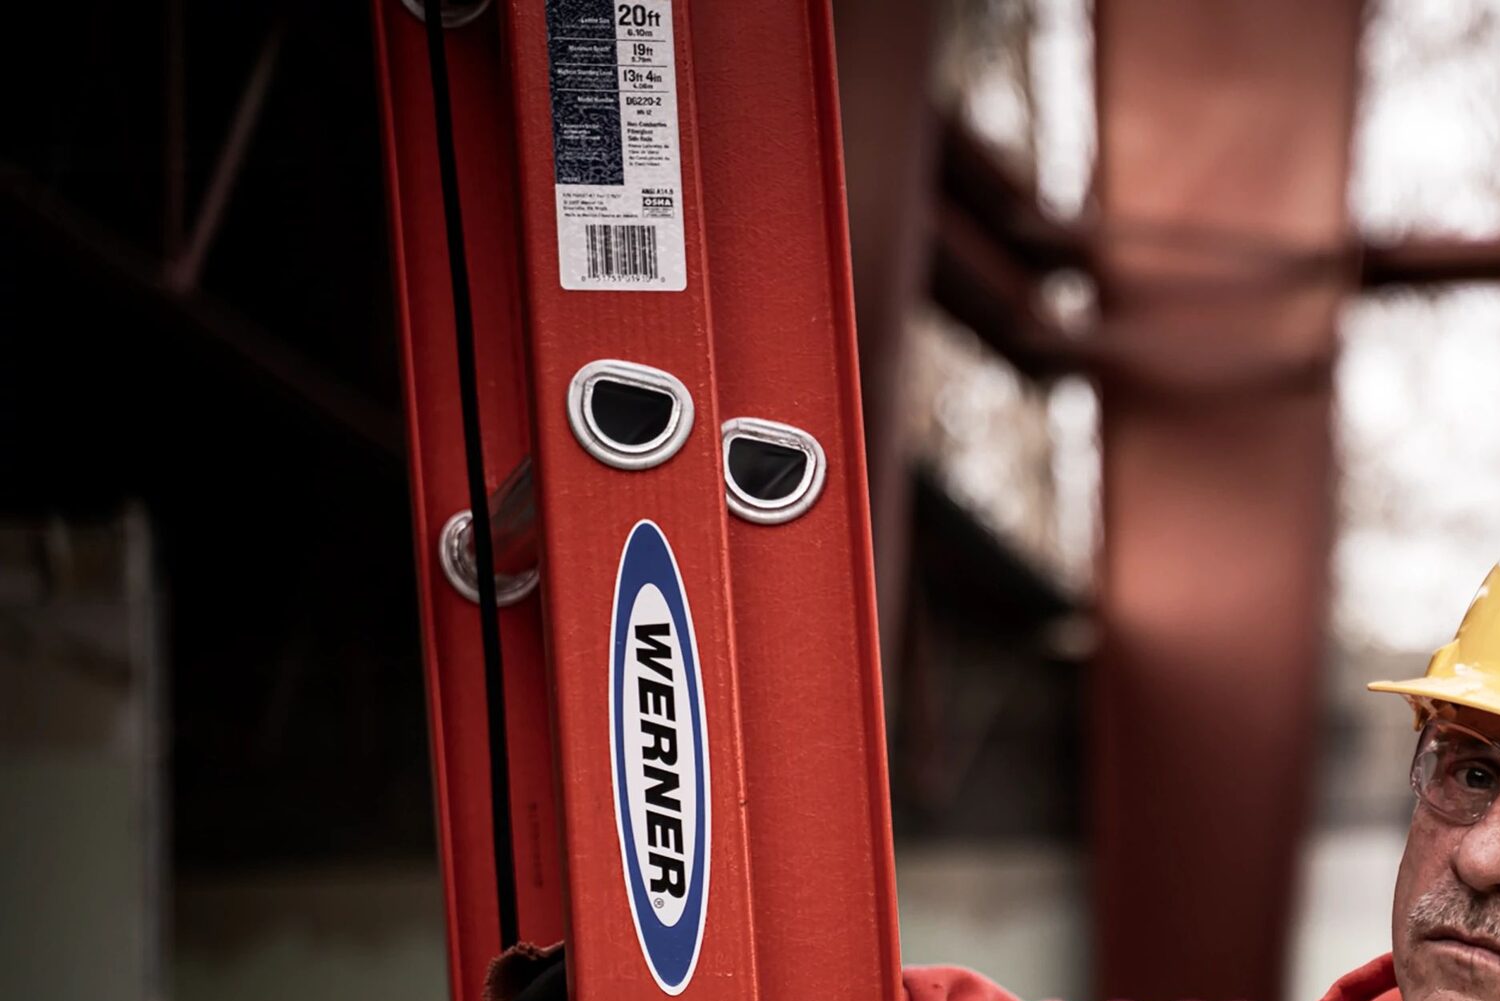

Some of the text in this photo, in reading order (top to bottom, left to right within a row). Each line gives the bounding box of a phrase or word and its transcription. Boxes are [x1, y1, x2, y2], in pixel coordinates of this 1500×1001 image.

[618, 5, 661, 27] 20ft
[627, 29, 653, 37] 6.10m
[633, 43, 653, 56] 19ft
[623, 70, 662, 82] 13ft 4in
[634, 622, 687, 899] WERNER
